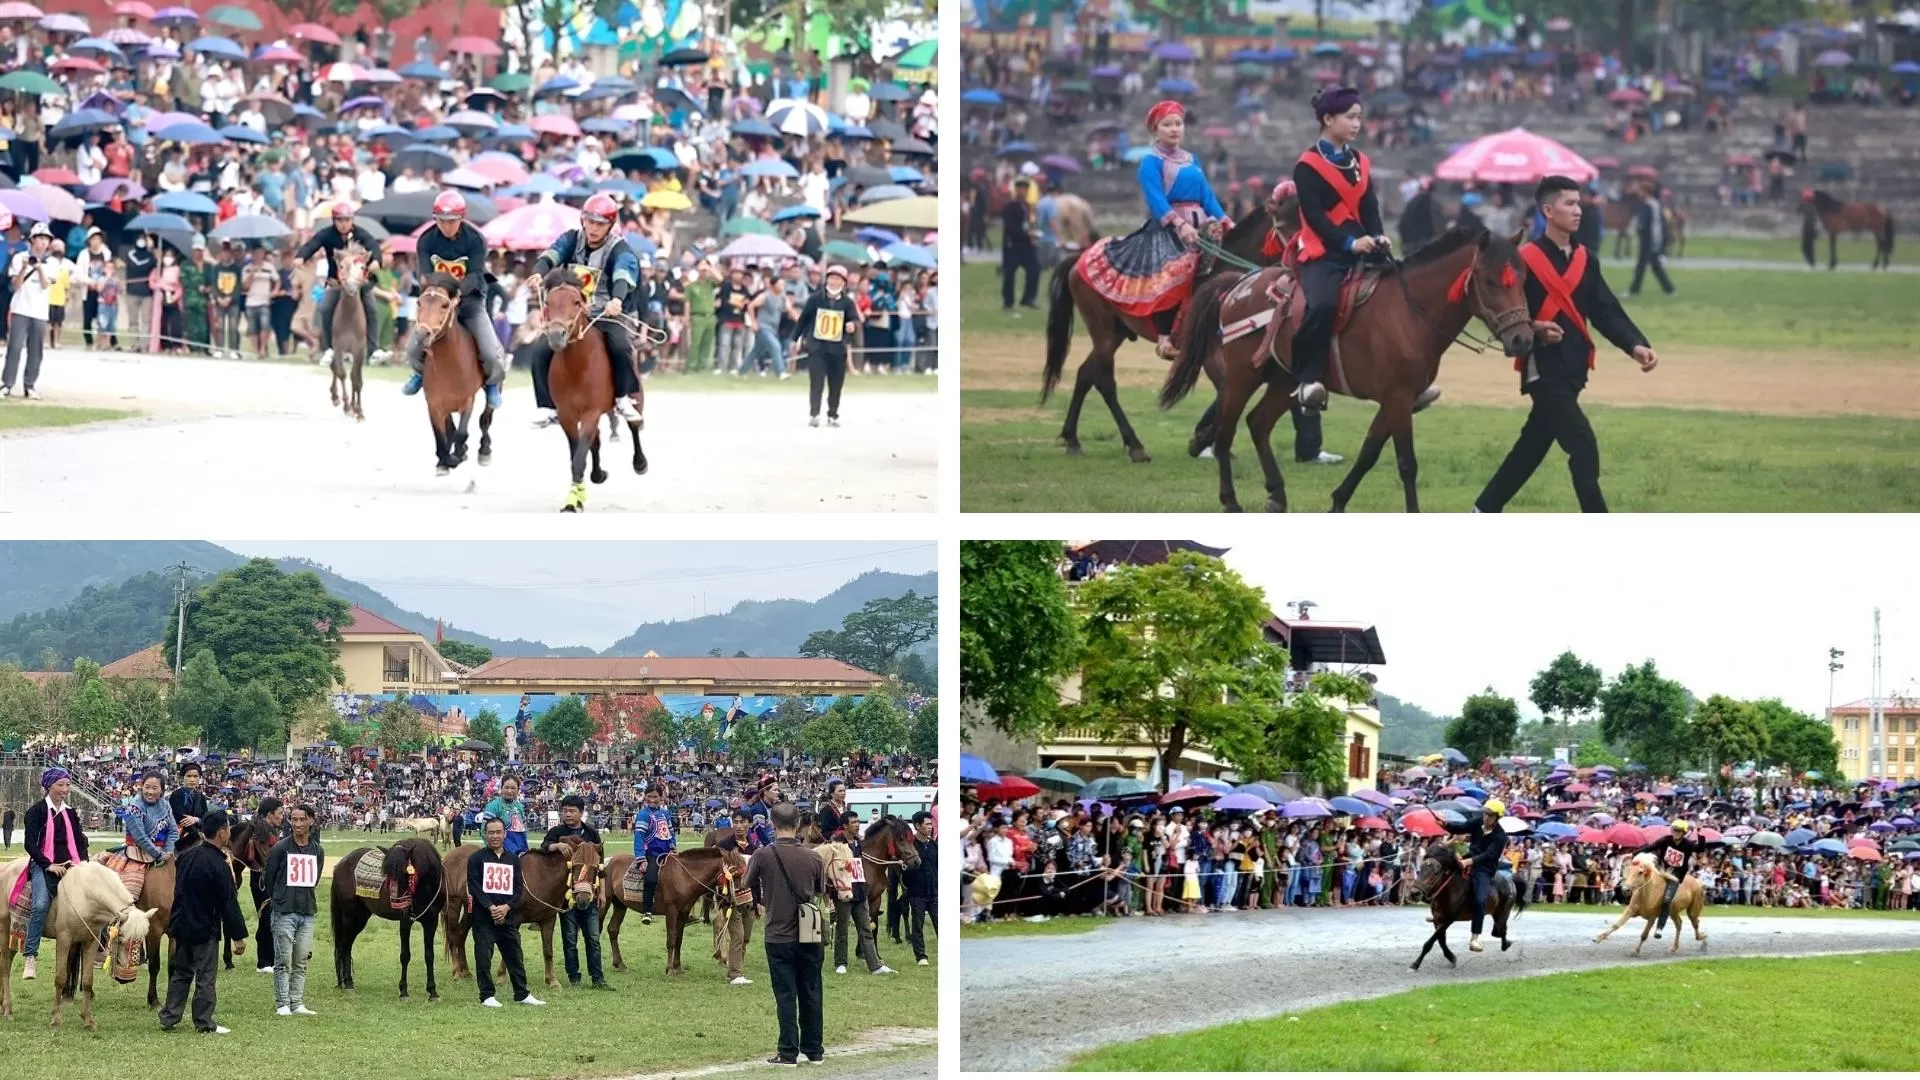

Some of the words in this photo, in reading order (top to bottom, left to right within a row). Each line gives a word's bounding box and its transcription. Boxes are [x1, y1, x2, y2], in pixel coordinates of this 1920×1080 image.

[820, 315, 837, 336] 01
[290, 857, 314, 882] 311
[486, 866, 510, 891] 333
